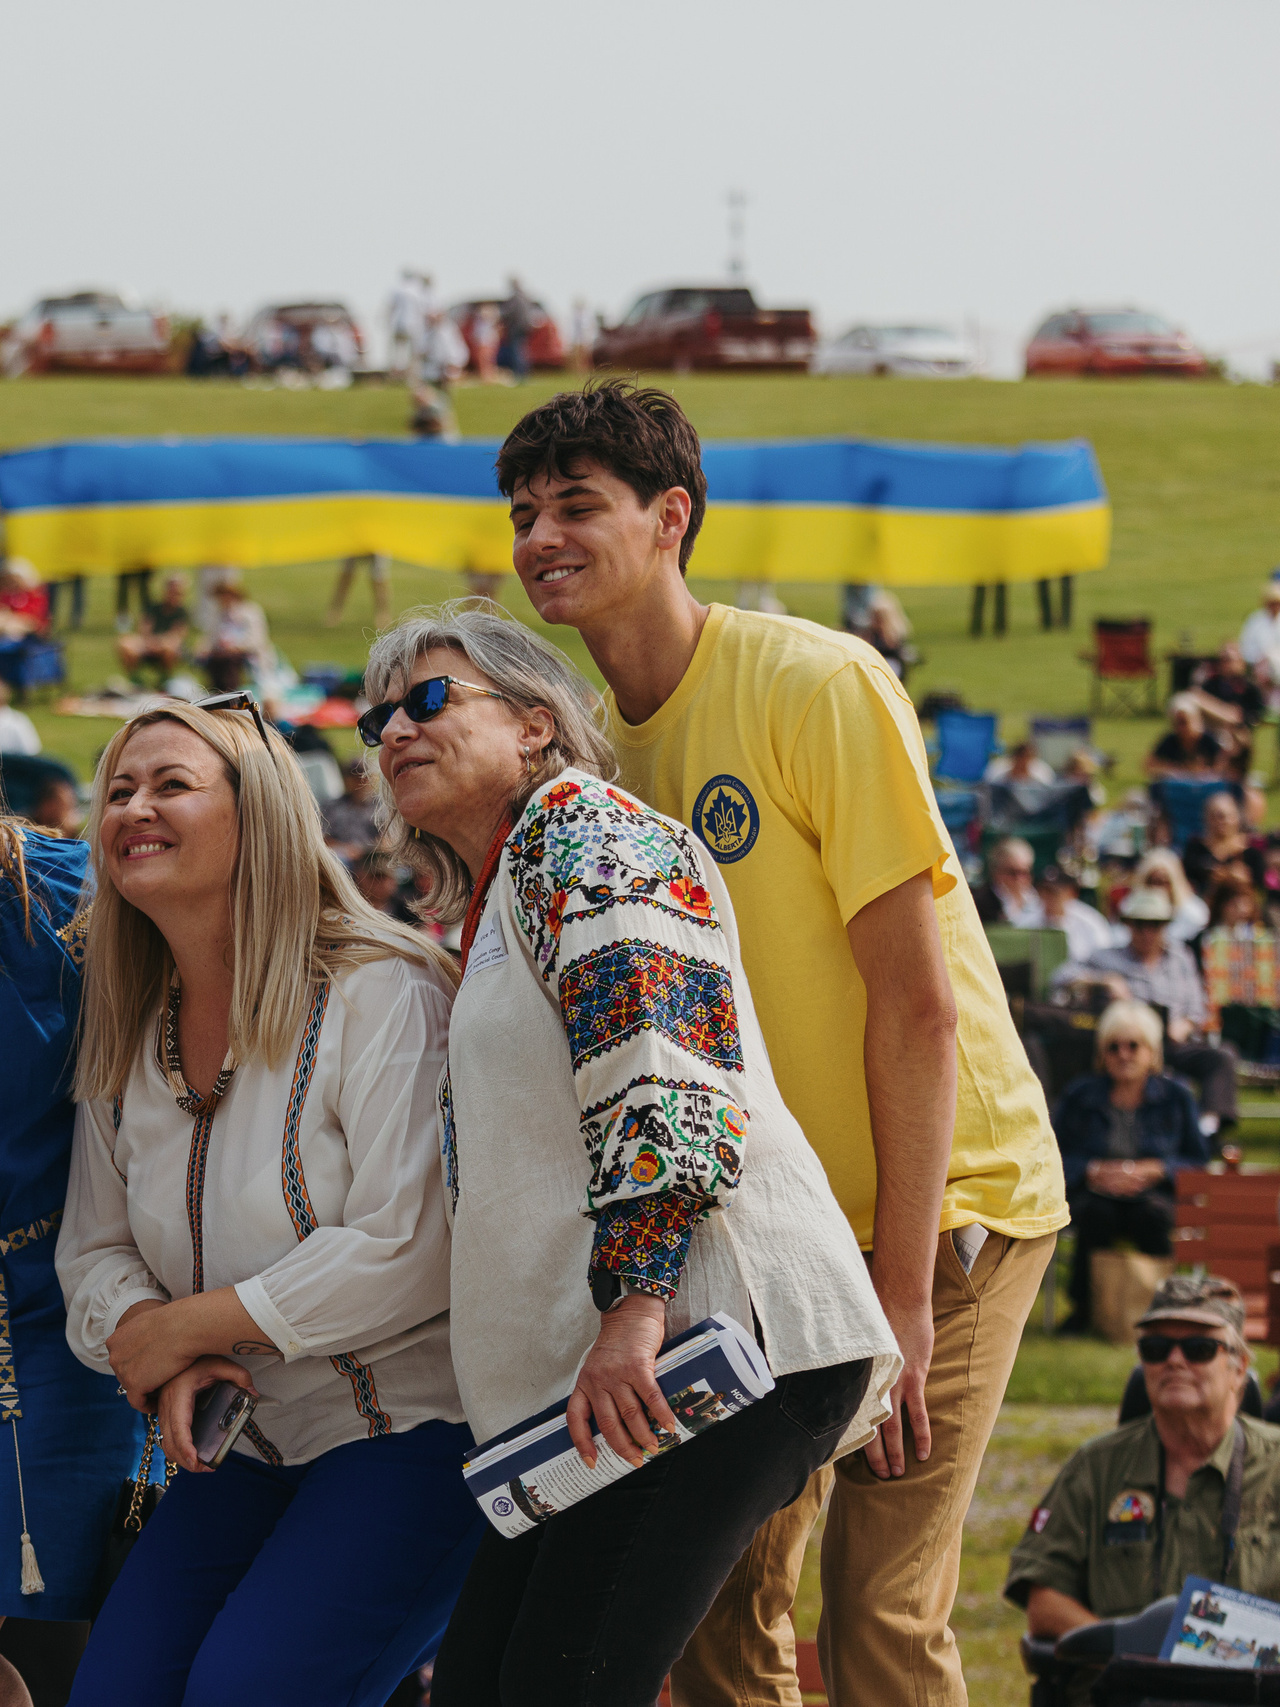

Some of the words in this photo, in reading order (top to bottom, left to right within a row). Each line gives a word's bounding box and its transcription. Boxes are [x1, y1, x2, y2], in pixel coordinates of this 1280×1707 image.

[710, 778, 731, 788] Canadian
[732, 780, 751, 804] Congress
[715, 838, 743, 850] ALBERTA
